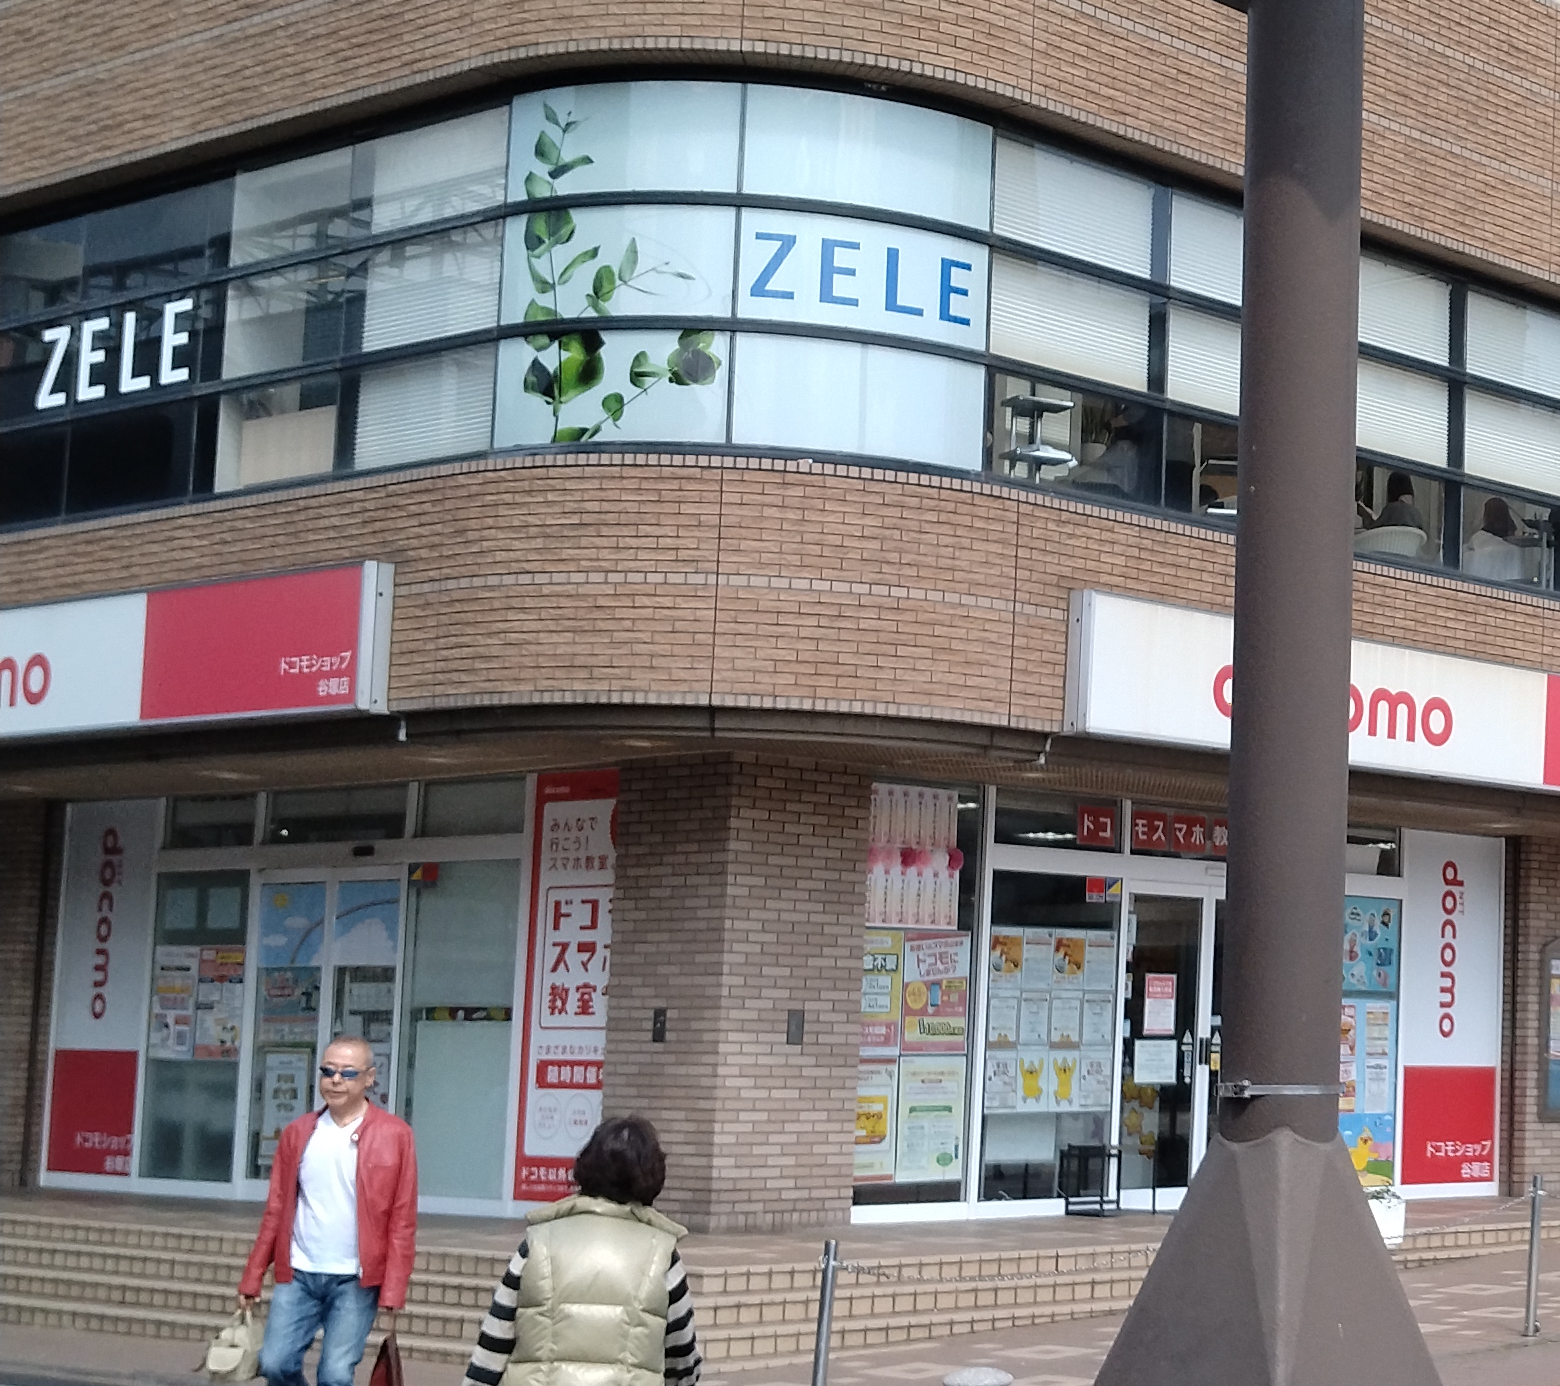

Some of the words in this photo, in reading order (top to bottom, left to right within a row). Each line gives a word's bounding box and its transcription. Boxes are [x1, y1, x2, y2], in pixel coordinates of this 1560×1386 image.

[750, 231, 972, 327] ZELE
[34, 298, 194, 411] ZELE
[280, 650, 353, 675] ドコモショップ
[550, 817, 599, 832] みんなで
[91, 826, 124, 1020] docomo
[552, 898, 612, 932] ドコ
[1438, 860, 1465, 1038] docomo
[548, 982, 598, 1016] 教室
[1426, 1140, 1492, 1158] ドコモショップ
